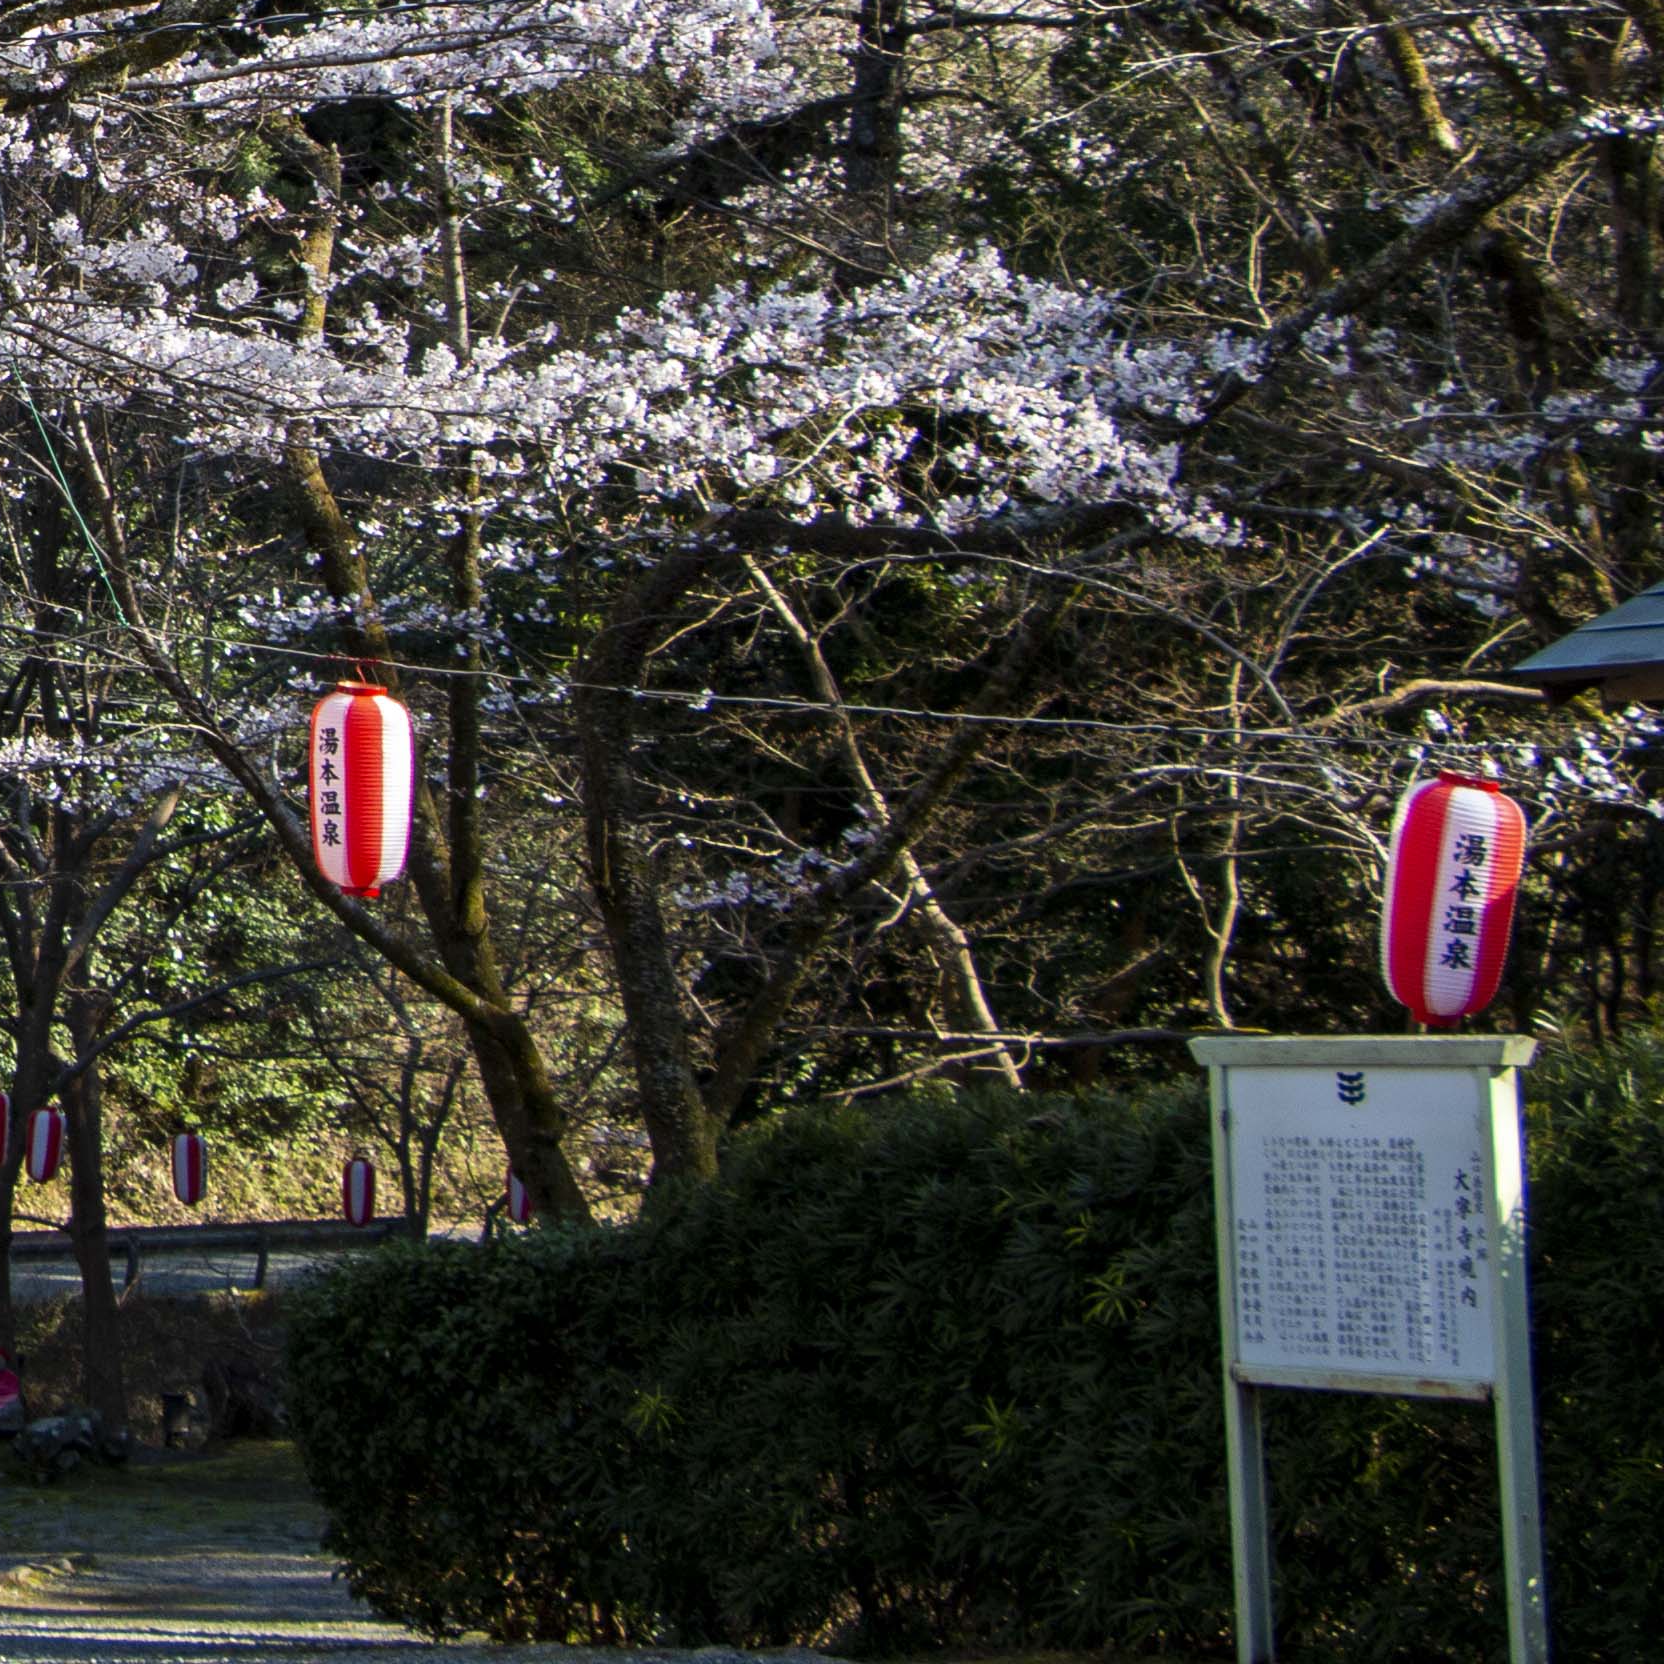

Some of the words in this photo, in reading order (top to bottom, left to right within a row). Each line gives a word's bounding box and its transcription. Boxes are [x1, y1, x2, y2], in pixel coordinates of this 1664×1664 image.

[319, 727, 342, 847] 湯本温泉
[1438, 833, 1488, 969] 湯本温泉
